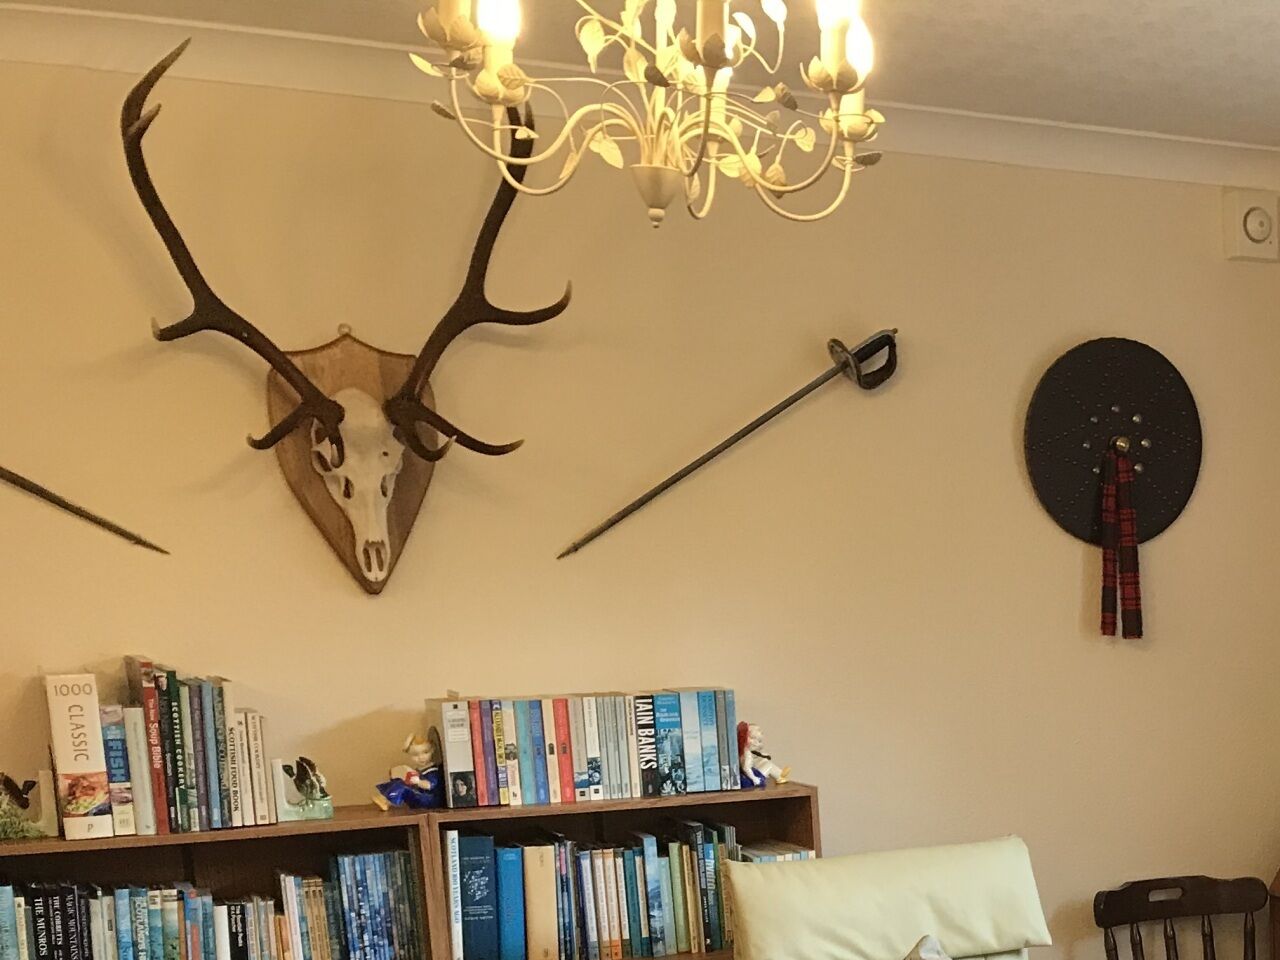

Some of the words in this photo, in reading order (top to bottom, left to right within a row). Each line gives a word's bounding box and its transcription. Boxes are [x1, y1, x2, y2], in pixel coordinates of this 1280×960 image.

[54, 683, 93, 696] 1000
[171, 701, 182, 745] SCOTTISH
[635, 698, 655, 724] IAIN
[67, 704, 89, 762] CLASSIC
[148, 723, 158, 745] Soup
[229, 727, 237, 765] SCOTTISH
[637, 729, 657, 770] BANKS
[109, 740, 126, 783] FISH
[152, 746, 161, 769] Bible
[176, 749, 185, 790] COOKERY
[34, 897, 43, 916] THE
[53, 896, 61, 909] THE
[36, 918, 48, 956] MUNROS
[54, 911, 63, 945] CORBETTS
[68, 918, 79, 960] MOUNTAINS
